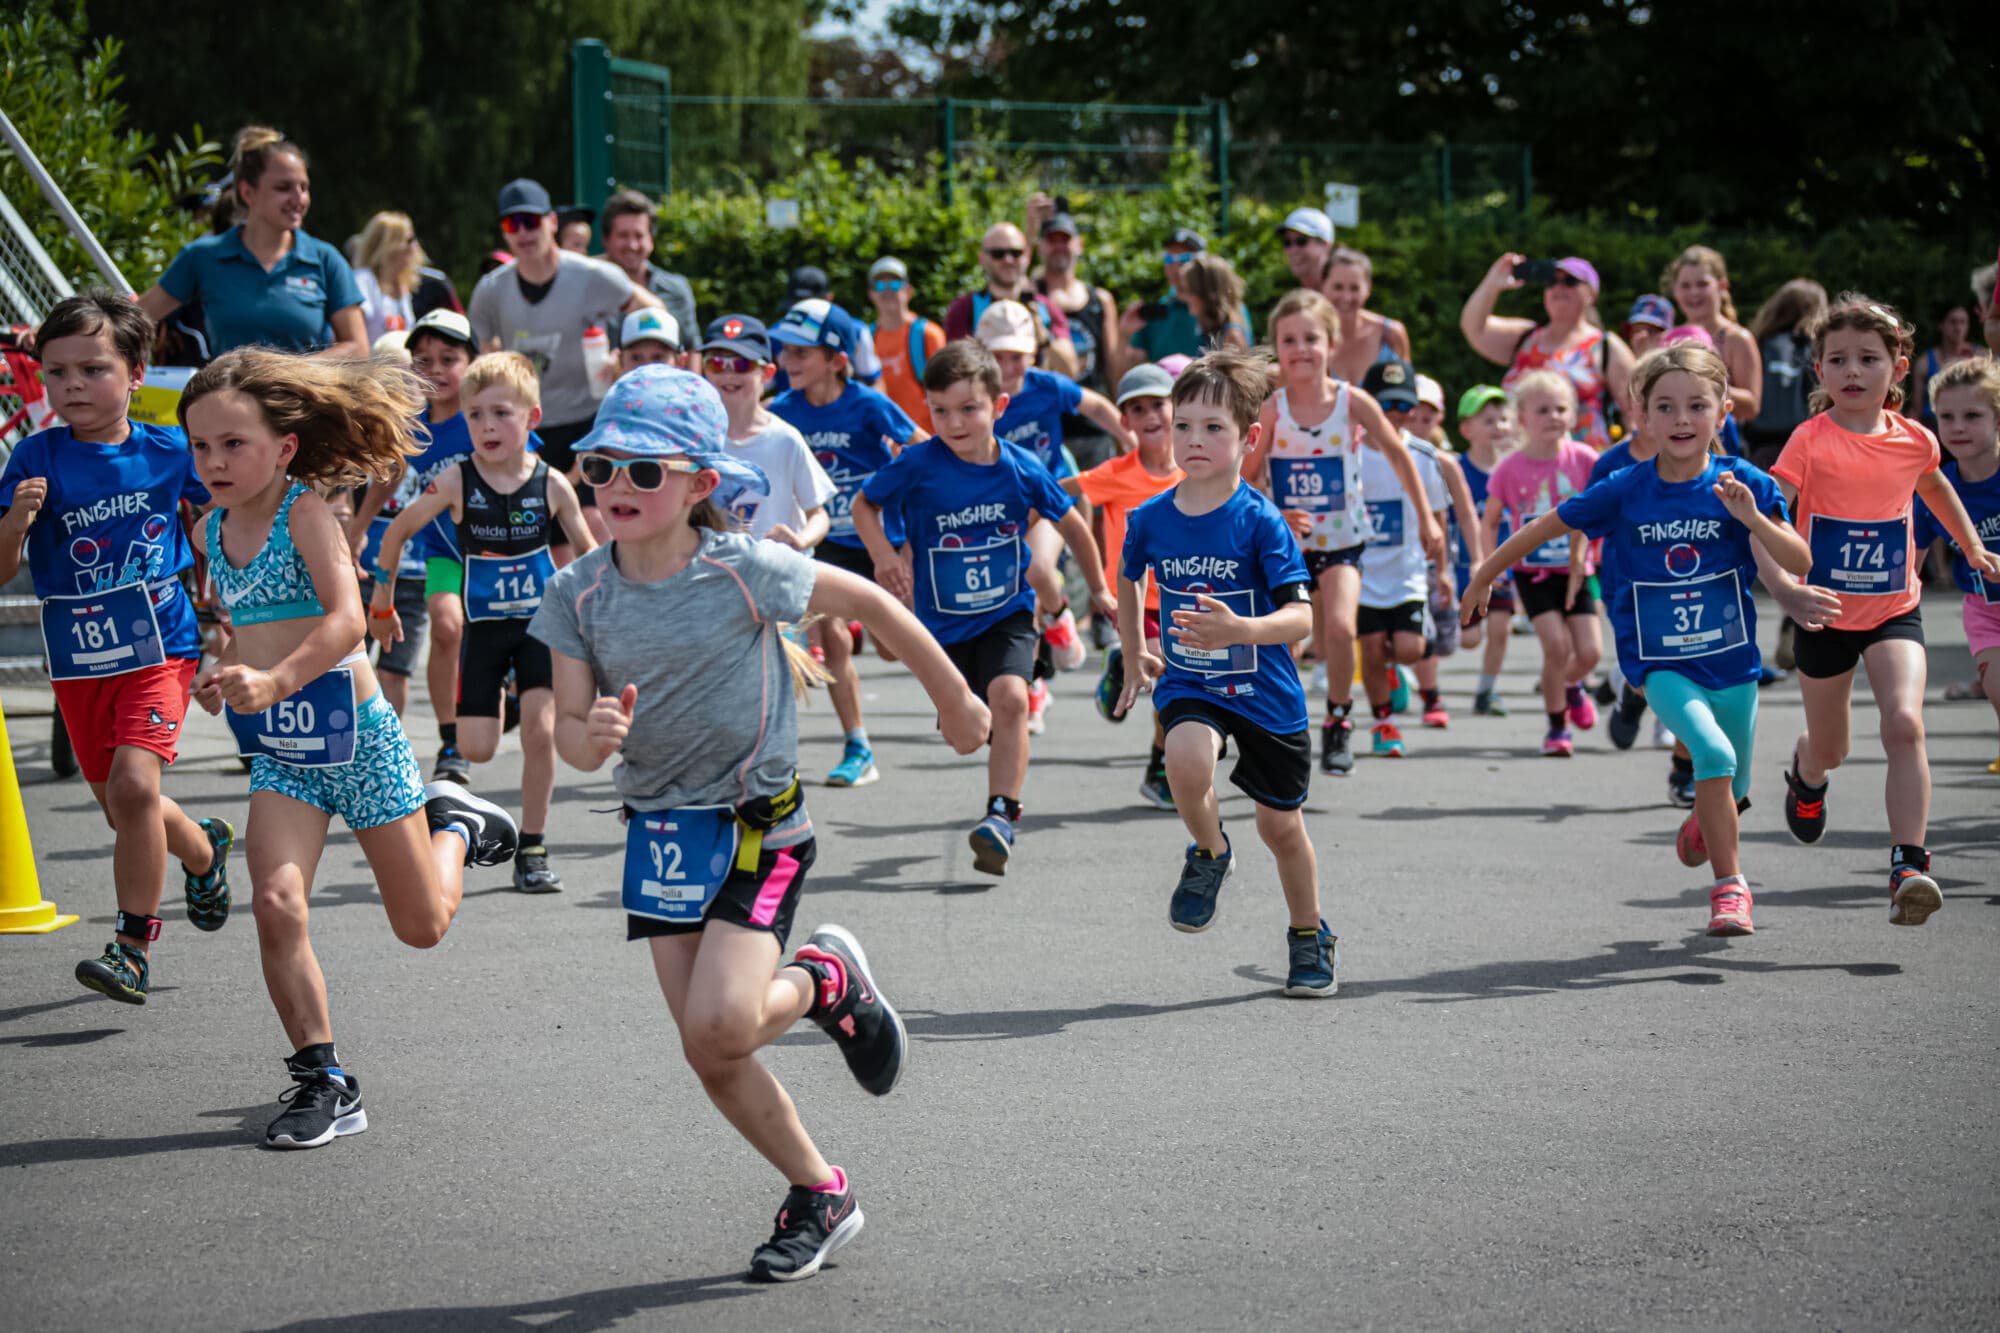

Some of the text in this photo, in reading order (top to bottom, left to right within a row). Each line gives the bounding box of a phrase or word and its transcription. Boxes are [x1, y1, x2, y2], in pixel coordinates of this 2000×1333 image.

[1287, 473, 1323, 495] 139
[61, 492, 151, 535] FINISHER
[936, 503, 1006, 532] FINISHER
[1638, 519, 1720, 544] FINISHER
[1161, 556, 1239, 580] FINISHER
[1839, 542, 1885, 569] 174
[495, 574, 536, 601] 114
[965, 566, 991, 590] 61
[1673, 604, 1704, 632] 37
[71, 616, 120, 650] 181
[1185, 648, 1211, 658] Nathan
[261, 701, 315, 734] 150
[279, 740, 298, 749] Nela
